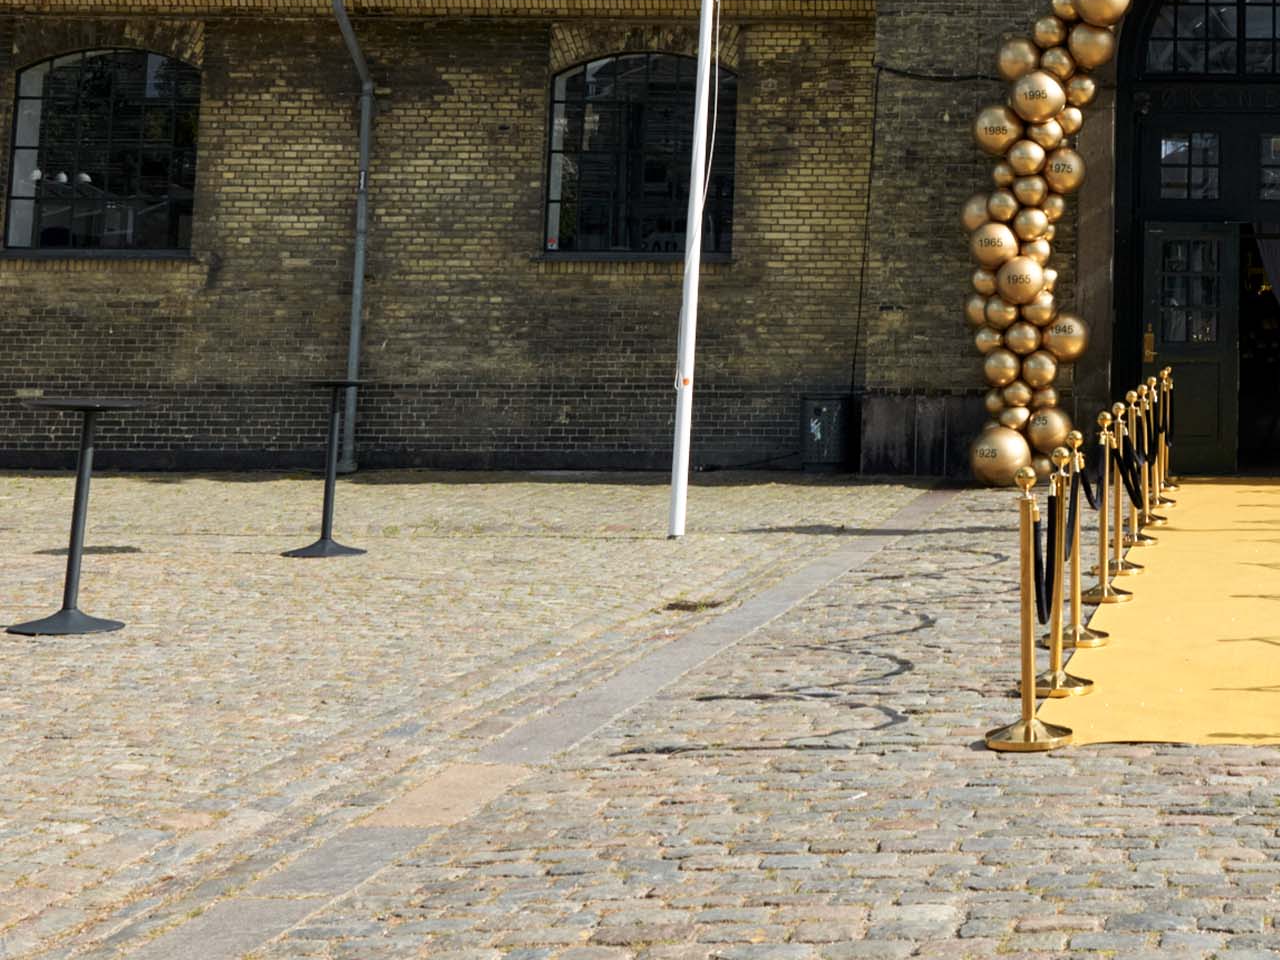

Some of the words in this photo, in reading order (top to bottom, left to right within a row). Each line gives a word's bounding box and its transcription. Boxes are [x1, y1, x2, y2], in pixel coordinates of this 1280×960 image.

[1023, 90, 1048, 101] 1995
[983, 126, 1008, 136] 1985
[1049, 163, 1073, 174] 1975
[977, 238, 1003, 248] 1965
[1006, 274, 1031, 285] 1955
